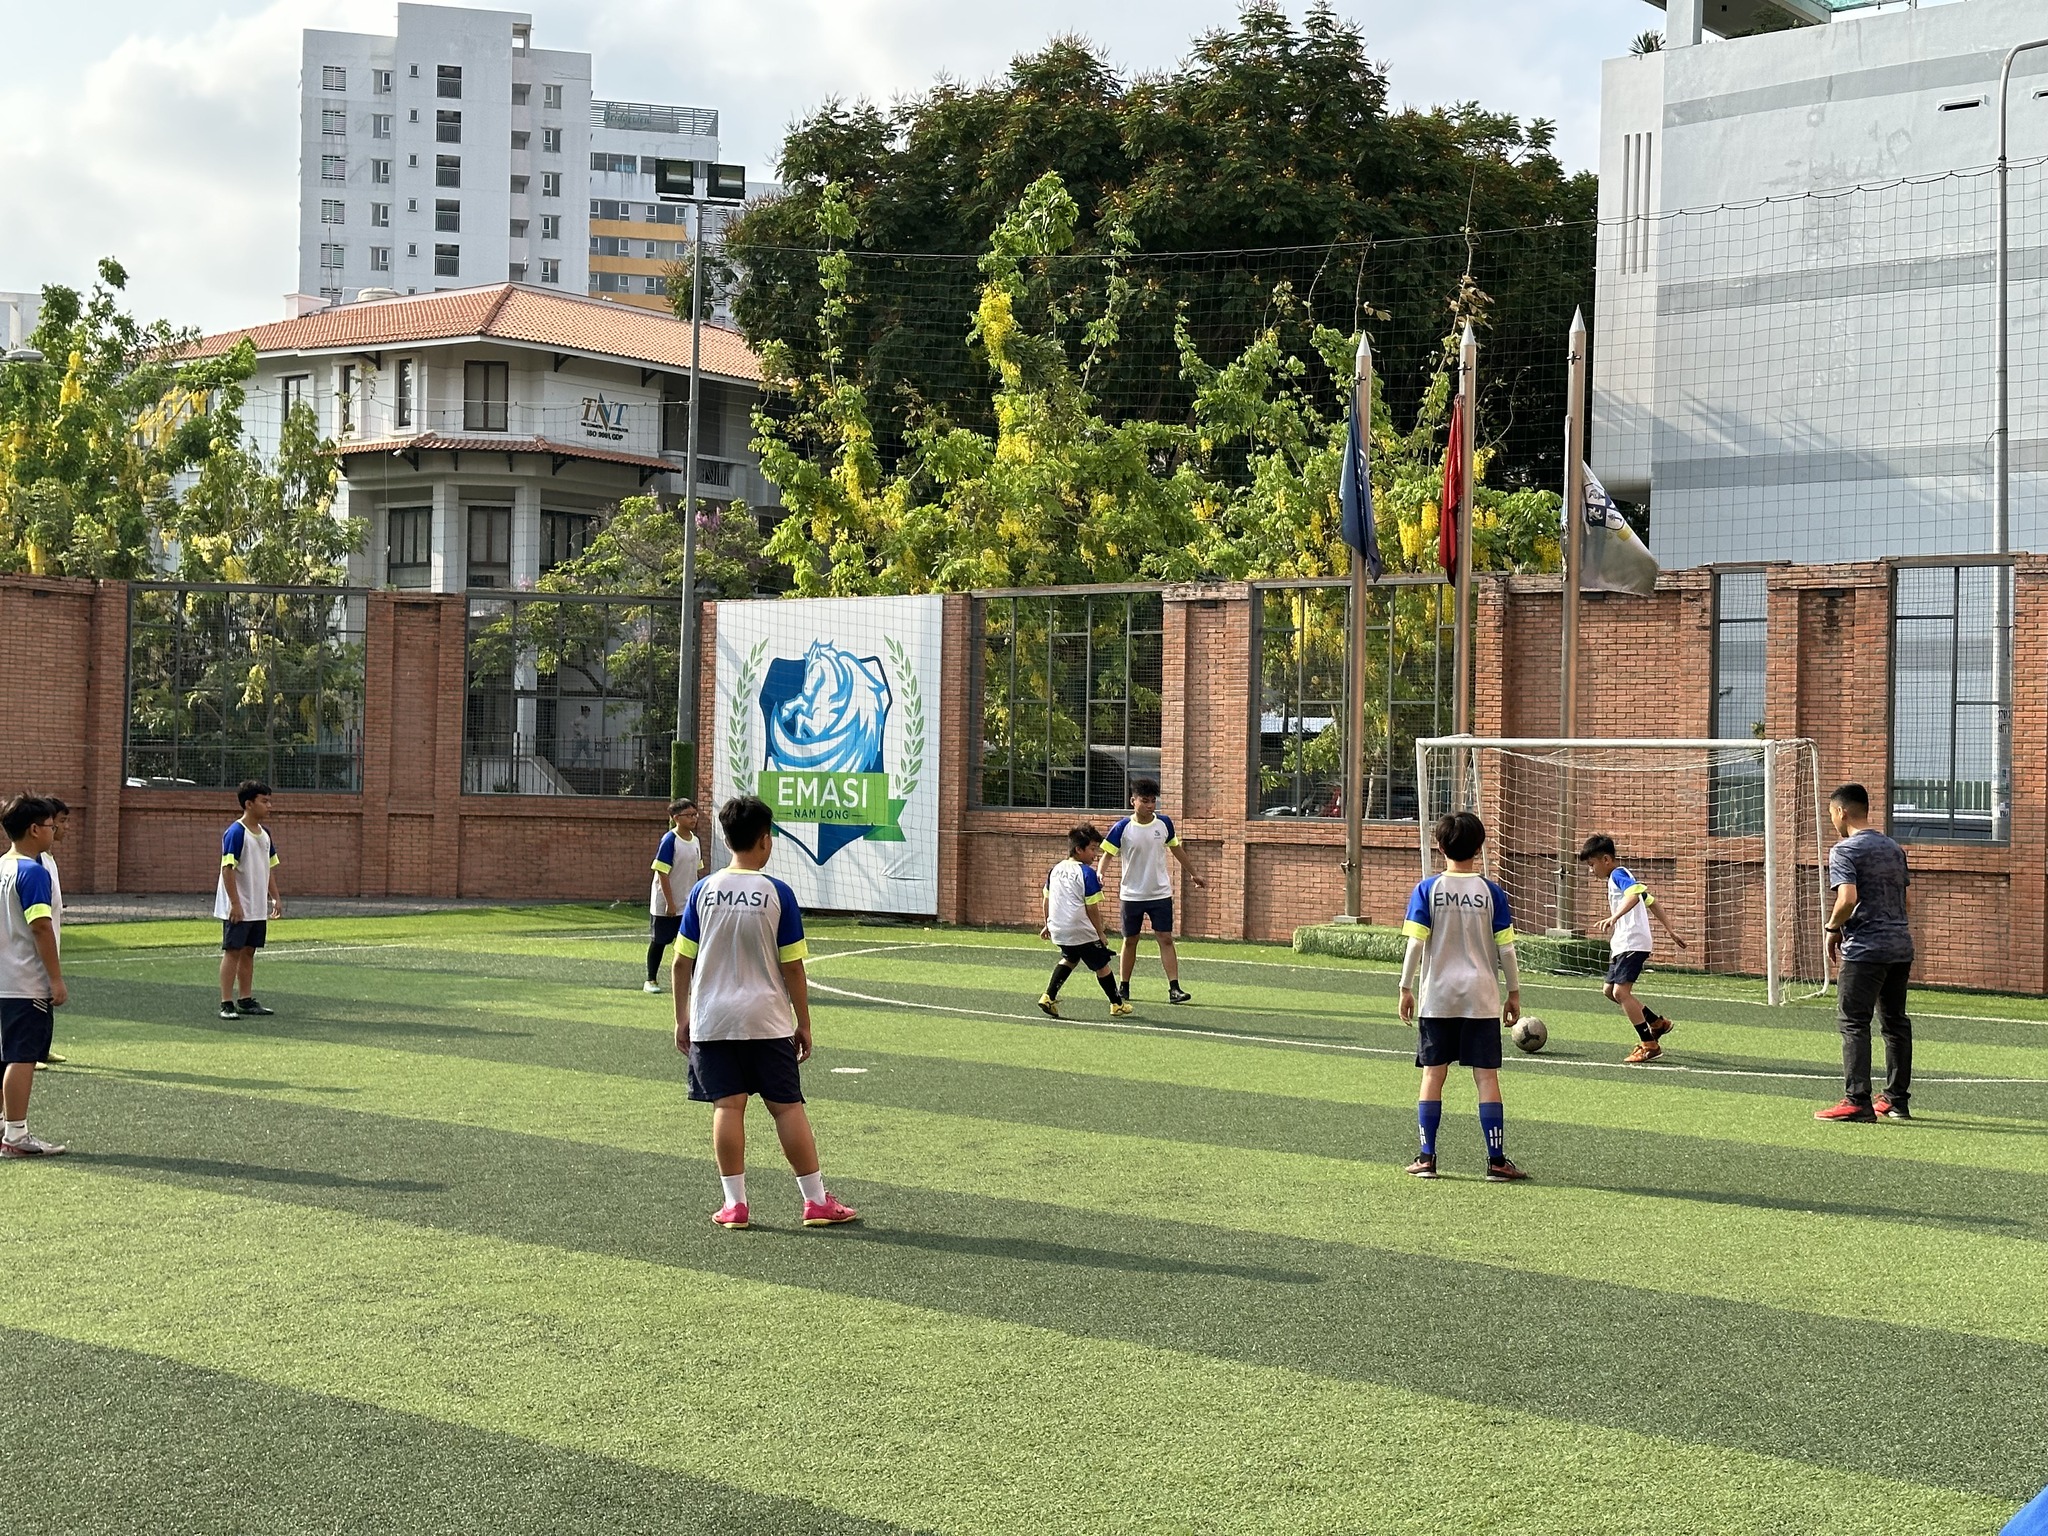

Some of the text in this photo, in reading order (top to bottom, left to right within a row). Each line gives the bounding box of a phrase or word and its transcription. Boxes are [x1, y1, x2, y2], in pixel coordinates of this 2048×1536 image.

[580, 392, 629, 432] TNT
[778, 776, 868, 808] EMASI
[794, 808, 849, 819] NAM LONG
[1052, 869, 1079, 881] MASI
[704, 890, 769, 909] EMASI
[1434, 892, 1489, 909] EMASI
